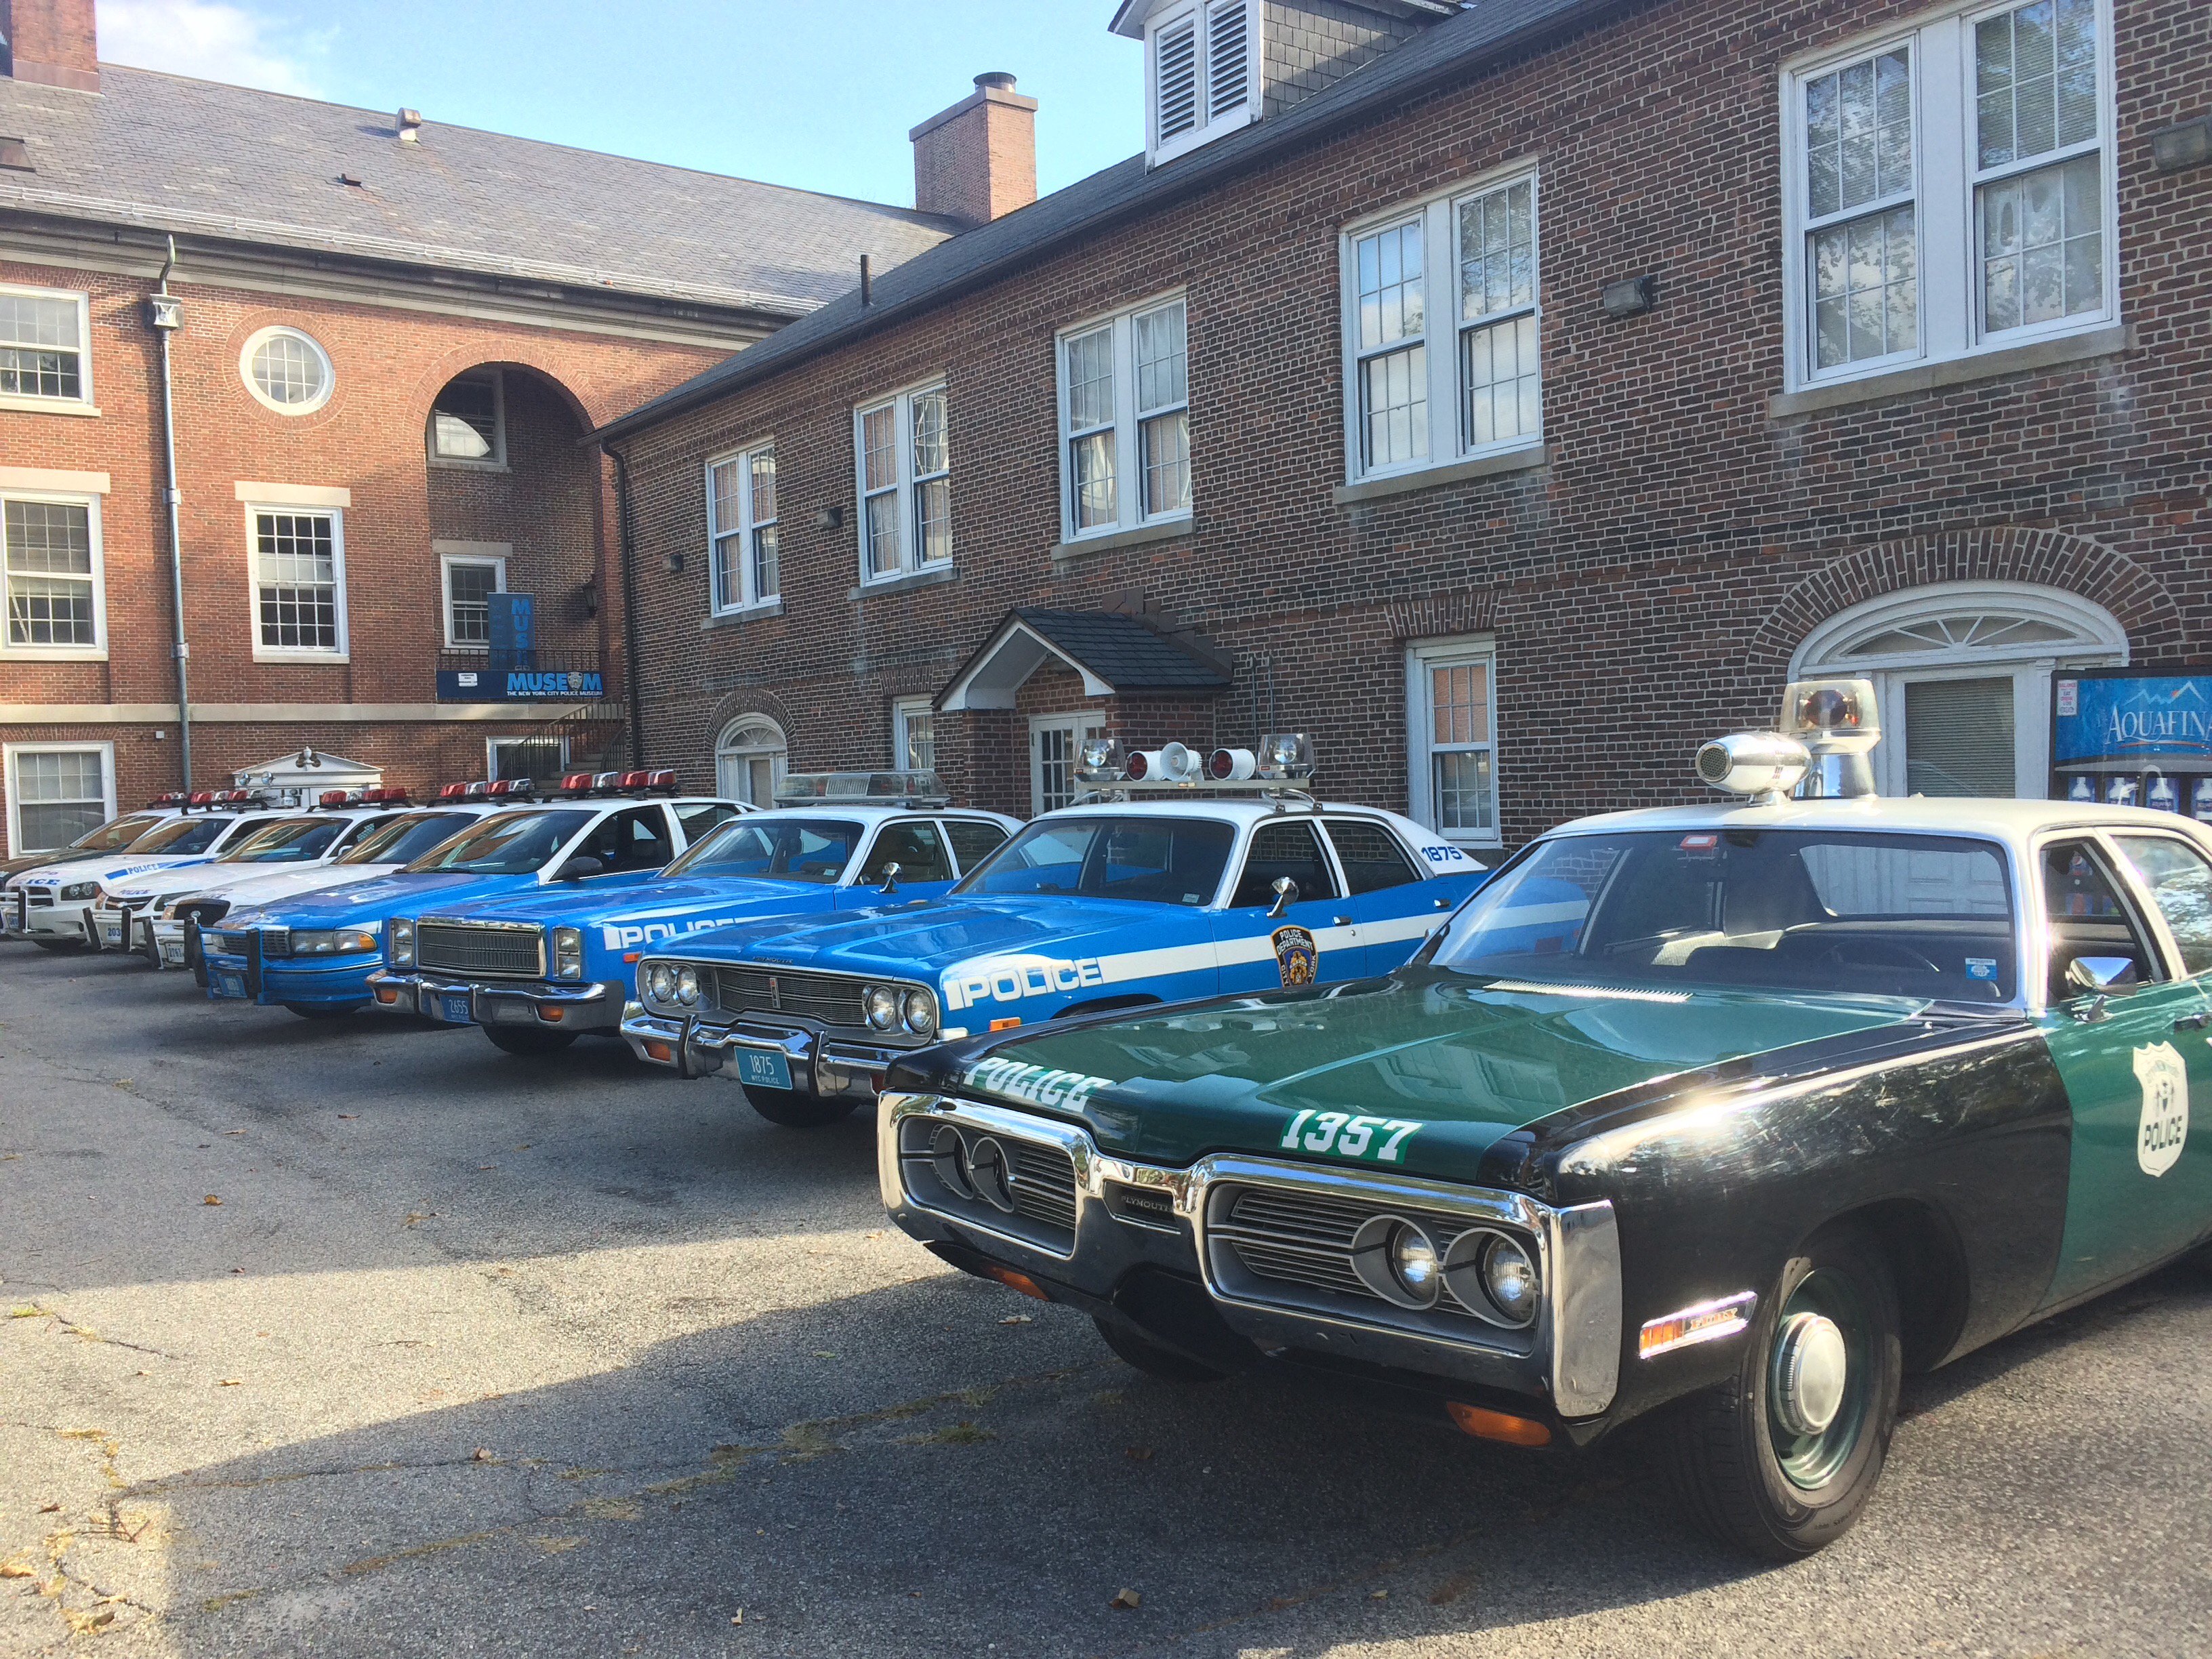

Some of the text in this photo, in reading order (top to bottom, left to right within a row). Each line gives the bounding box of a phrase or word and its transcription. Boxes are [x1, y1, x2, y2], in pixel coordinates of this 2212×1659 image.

[1420, 846, 1462, 862] 1875
[127, 863, 157, 874] POLICE
[108, 927, 123, 937] 203
[1279, 929, 1303, 941] POLICE
[1276, 937, 1313, 956] DEPARTMENT
[1281, 964, 1289, 985] CITY
[1308, 954, 1316, 978] YORK
[960, 958, 1103, 1008] POLICE
[448, 999, 468, 1015] 2655
[749, 1054, 775, 1075] 1875
[762, 1076, 780, 1084] POLICE
[963, 1057, 1115, 1112] POLICE
[1281, 1109, 1423, 1161] 1357
[2143, 1115, 2183, 1154] POLICE
